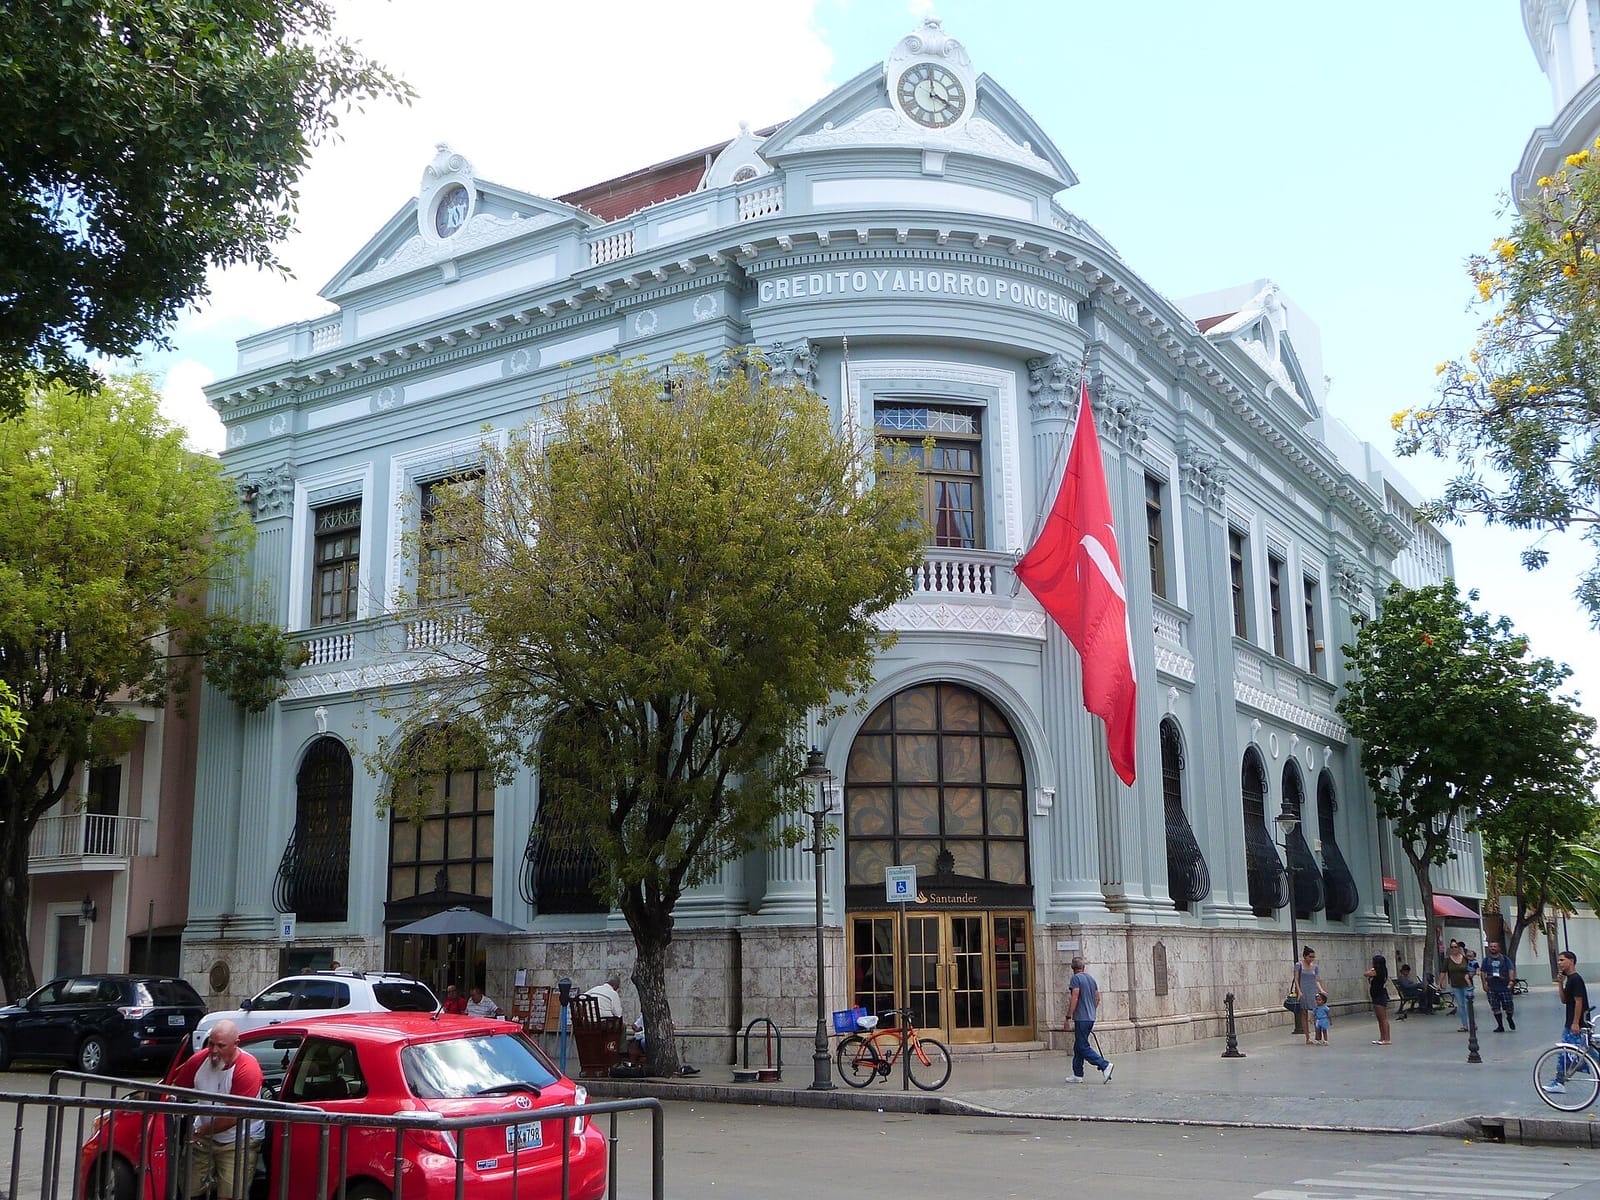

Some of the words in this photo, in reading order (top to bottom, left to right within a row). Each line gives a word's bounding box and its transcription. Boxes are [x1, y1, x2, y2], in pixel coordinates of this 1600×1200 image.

[760, 271, 867, 302] CREDITO
[871, 270, 889, 291] Y
[892, 270, 990, 297] AHORRO
[930, 892, 978, 904] Santander
